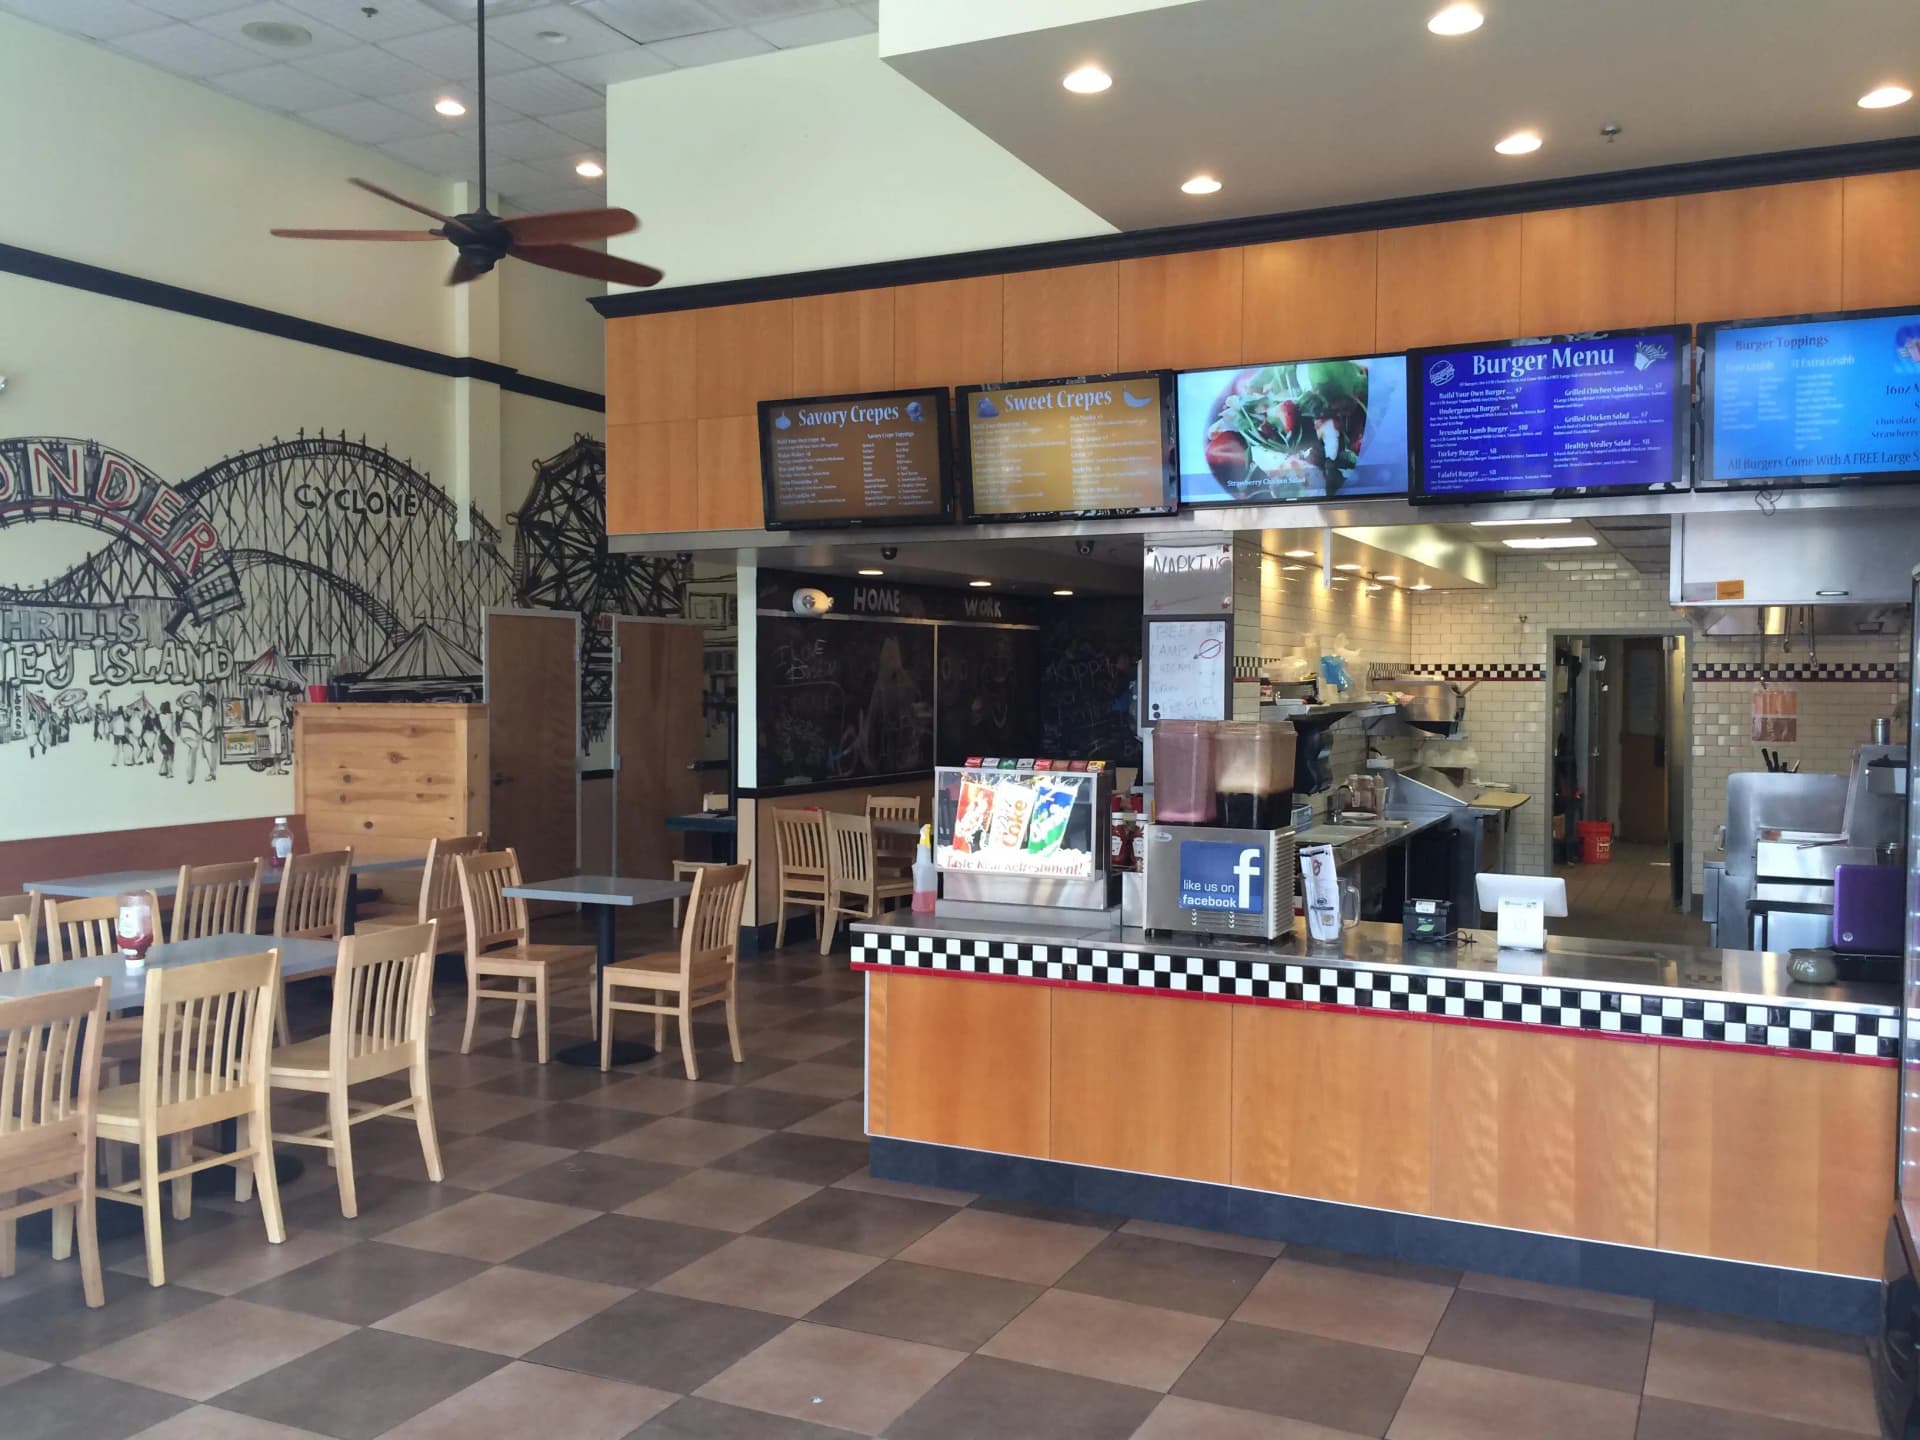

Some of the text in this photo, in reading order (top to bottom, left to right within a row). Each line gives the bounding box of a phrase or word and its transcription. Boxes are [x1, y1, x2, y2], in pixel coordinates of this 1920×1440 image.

[1735, 335, 1829, 352] Burger Toppings
[1472, 347, 1615, 378] Burger Menu
[1485, 389, 1506, 397] Burger
[1565, 387, 1586, 396] Grilled
[1586, 386, 1612, 394] Chicken
[1612, 384, 1643, 392] Sandwich
[1004, 389, 1112, 412] Sweet Crepes
[799, 405, 899, 428] Savory Crepes
[1439, 405, 1479, 415] Underground
[1565, 415, 1586, 423] Grilled
[1586, 413, 1612, 421] Chicken
[1612, 411, 1630, 419] Salad
[1439, 428, 1468, 436] Jerusalem
[1565, 442, 1589, 450] Healthy
[1589, 440, 1613, 449] Medley
[1613, 439, 1631, 447] Salad
[1438, 449, 1458, 458] Turkey
[1728, 459, 1741, 471] All
[1743, 458, 1783, 471] Burgers
[1785, 456, 1814, 468] Come
[1816, 454, 1841, 466] With
[1843, 454, 1853, 465] A
[1853, 452, 1879, 464] FREE
[1881, 451, 1911, 465] Large
[1227, 479, 1261, 488] Strawberry
[1262, 478, 1288, 486] Chicken
[294, 484, 417, 518] CYCLONE
[854, 588, 900, 613] HOME
[964, 597, 1001, 617] WORK
[89, 637, 235, 687] ISLAND
[1002, 799, 1028, 848] Coke
[1183, 879, 1235, 893] like us on
[1233, 848, 1260, 909] f
[1182, 894, 1236, 908] facebook
